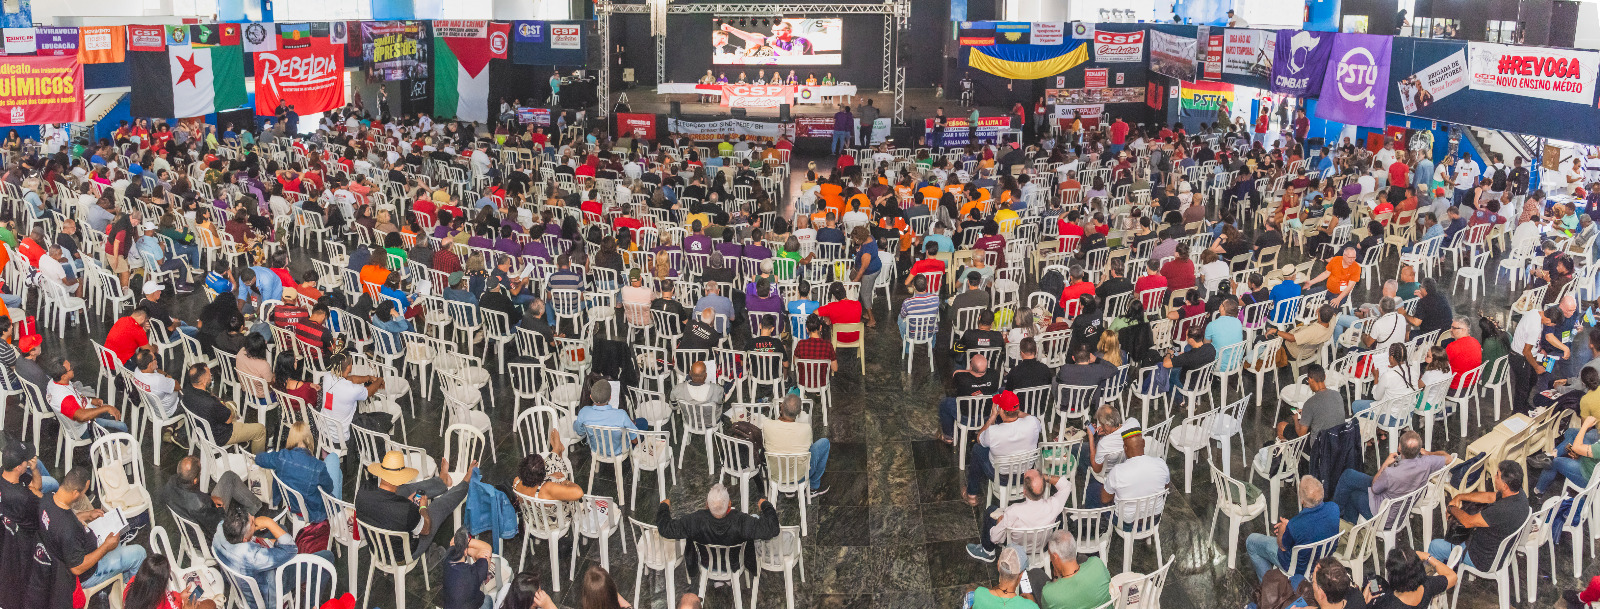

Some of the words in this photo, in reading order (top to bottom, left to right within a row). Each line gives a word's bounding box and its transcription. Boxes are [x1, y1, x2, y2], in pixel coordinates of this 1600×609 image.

[1097, 34, 1141, 43] CSP
[1097, 44, 1140, 55] Conlutas
[259, 53, 337, 101] REBELDIA
[1336, 62, 1378, 85] PSTU
[1428, 65, 1451, 80] BRIGADA
[1451, 60, 1460, 68] DE
[1428, 66, 1463, 87] TRADUTORES
[1497, 55, 1581, 79] #REVOGA
[734, 86, 783, 96] CSP
[1496, 76, 1518, 88] NOVO
[1519, 78, 1551, 91] ENSINO
[1553, 78, 1583, 93] MÉDIO
